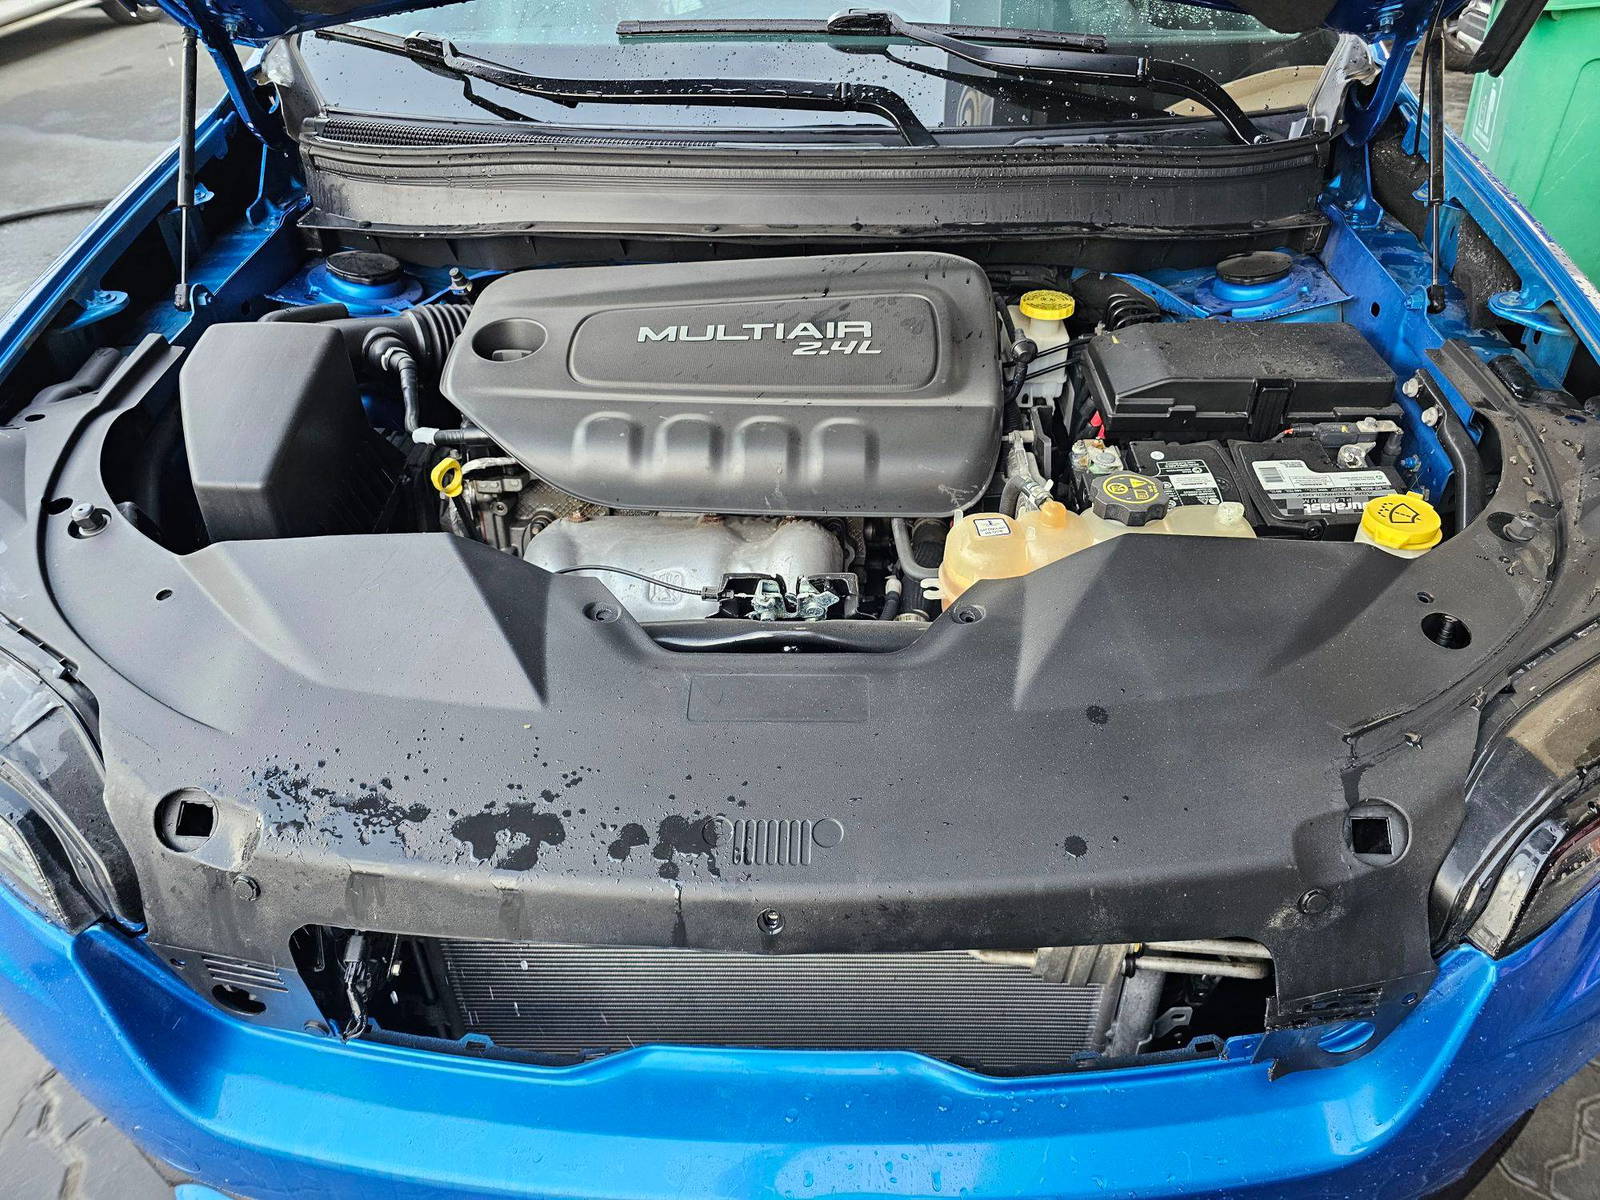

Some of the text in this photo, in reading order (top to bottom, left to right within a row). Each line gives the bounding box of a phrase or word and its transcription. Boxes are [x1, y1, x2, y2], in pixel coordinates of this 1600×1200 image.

[637, 320, 872, 342] MULTIAIR
[792, 340, 881, 356] 2.4L
[1303, 502, 1366, 513] uralast
